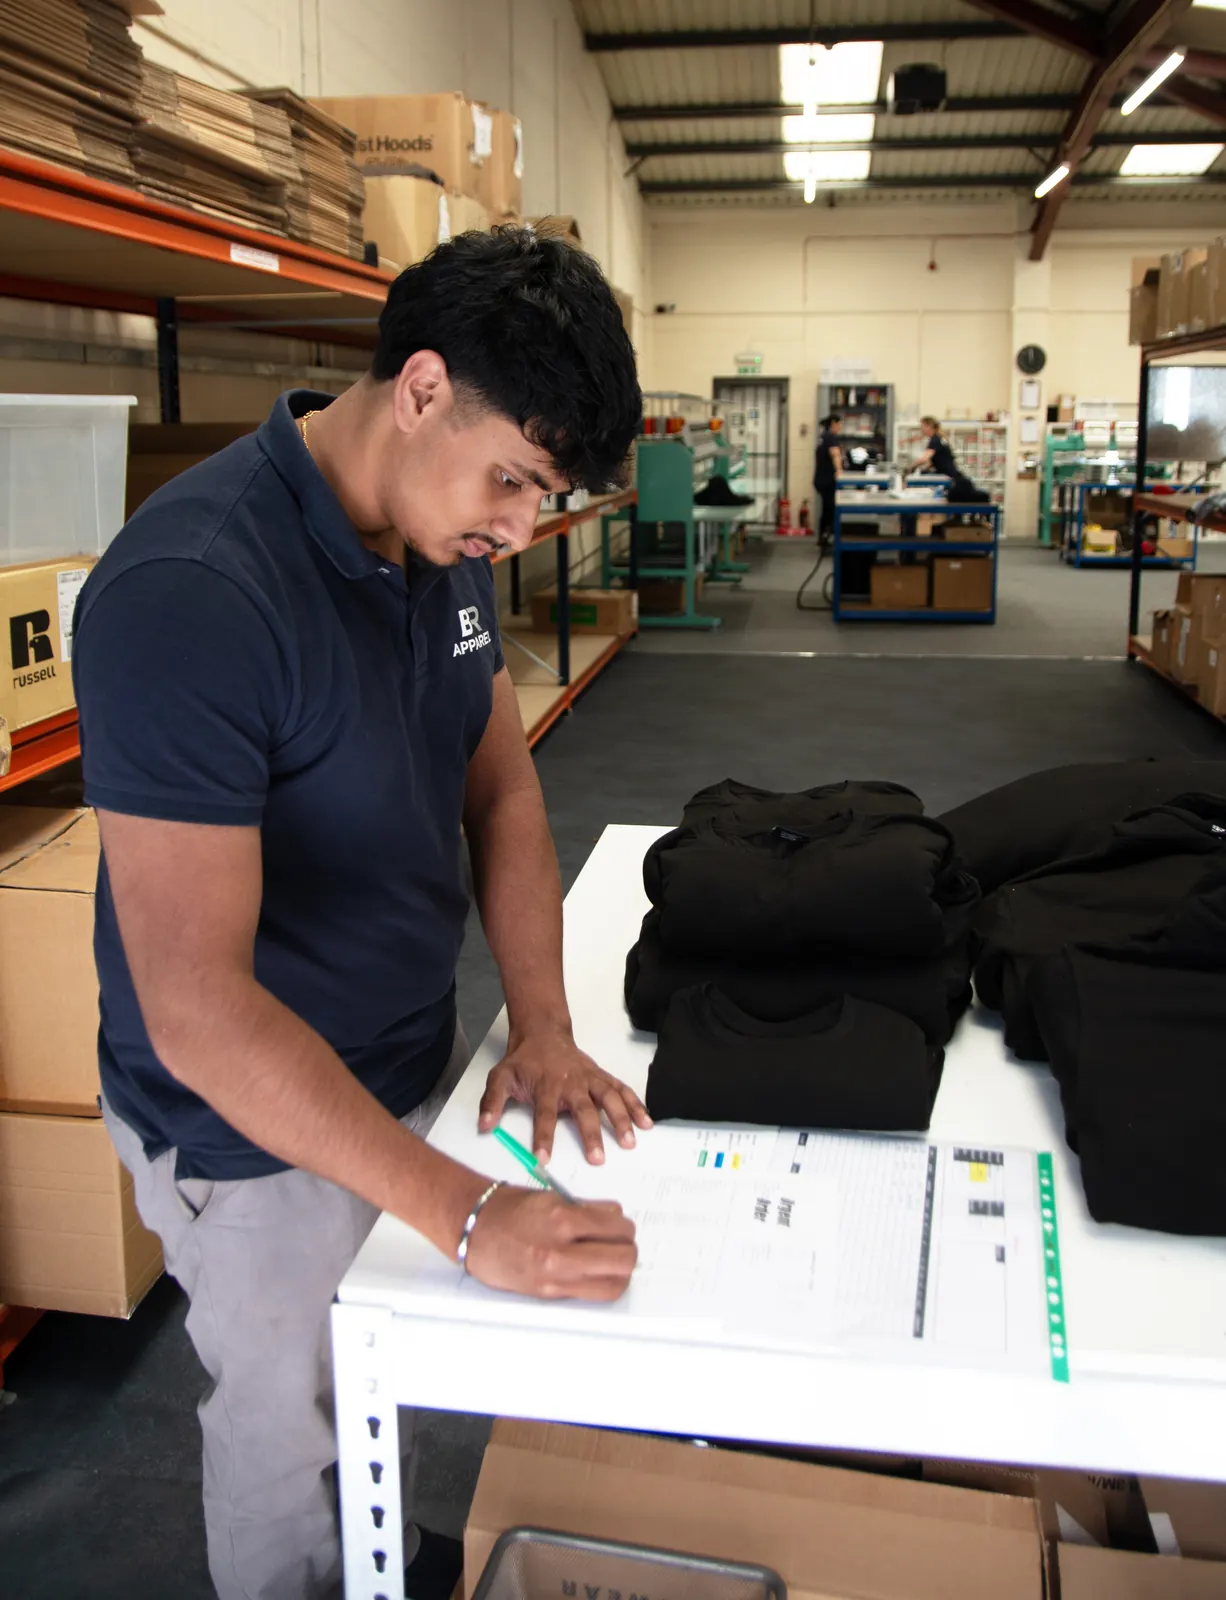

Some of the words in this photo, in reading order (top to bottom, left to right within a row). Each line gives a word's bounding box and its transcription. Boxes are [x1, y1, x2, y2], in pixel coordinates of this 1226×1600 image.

[358, 136, 373, 153] st
[376, 134, 433, 153] Hoods
[458, 605, 483, 638] BR
[452, 630, 492, 658] APPAREL
[13, 665, 57, 689] russell
